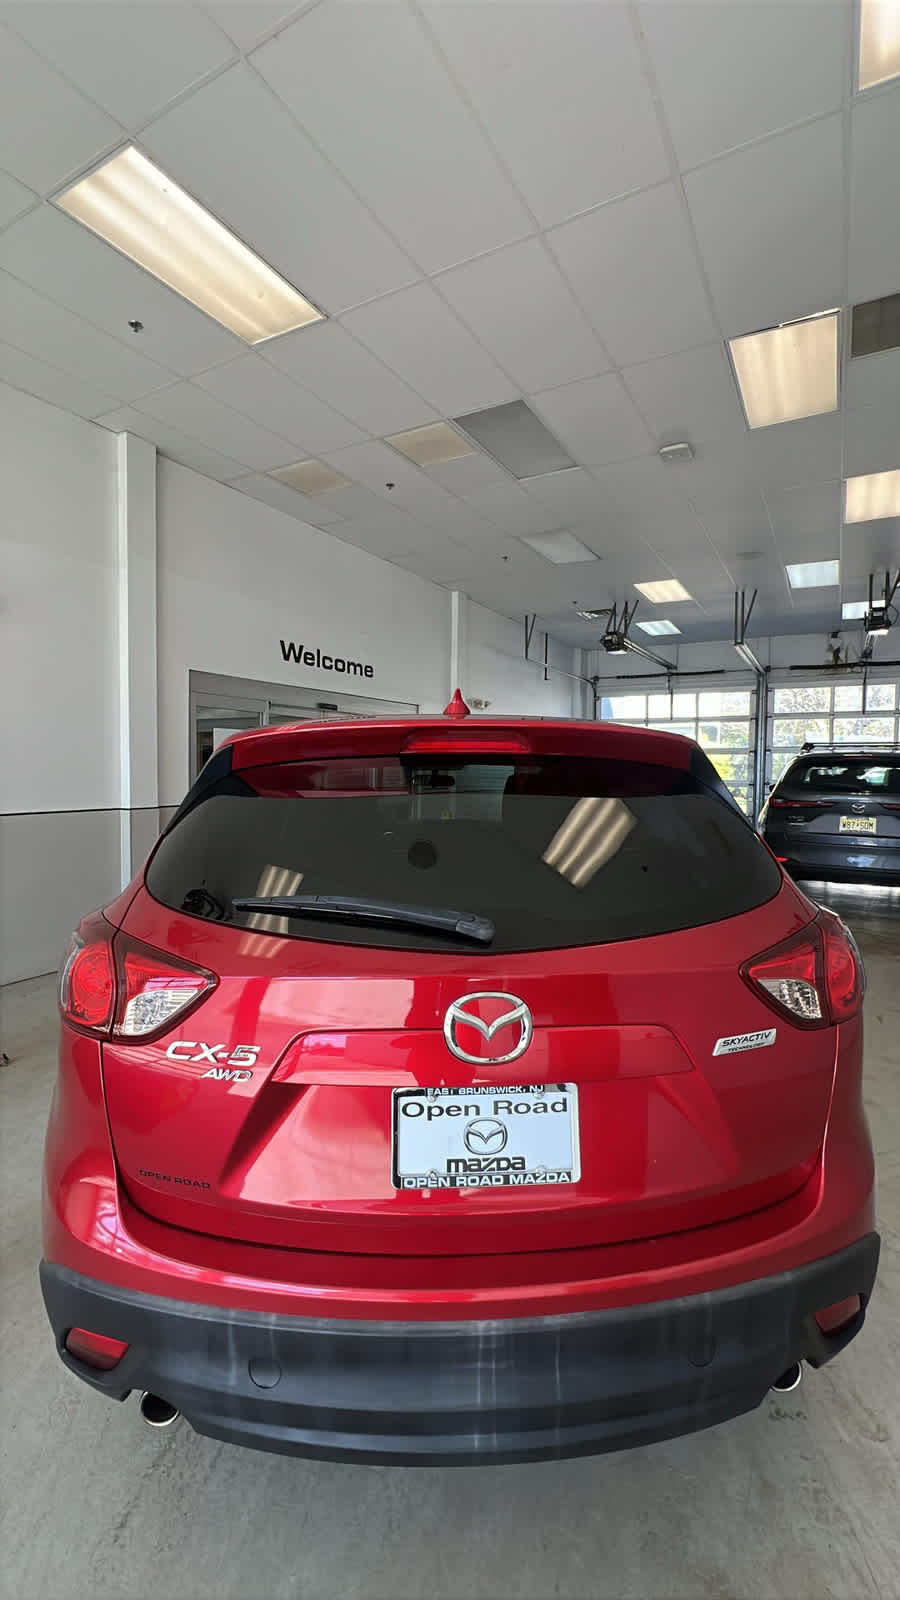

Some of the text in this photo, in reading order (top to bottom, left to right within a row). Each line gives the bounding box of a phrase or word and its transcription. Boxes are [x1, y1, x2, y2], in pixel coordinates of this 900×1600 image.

[280, 639, 374, 678] Welcome
[722, 1031, 771, 1047] SKYACTIV
[166, 1040, 261, 1067] CX-5
[201, 1067, 253, 1083] AWD
[427, 1083, 545, 1096] EAST BRUNSWICK, NJ
[401, 1097, 568, 1121] Open Road
[139, 1169, 211, 1189] OPEN ROAD
[403, 1172, 570, 1188] OPEN ROAD MAZDA
